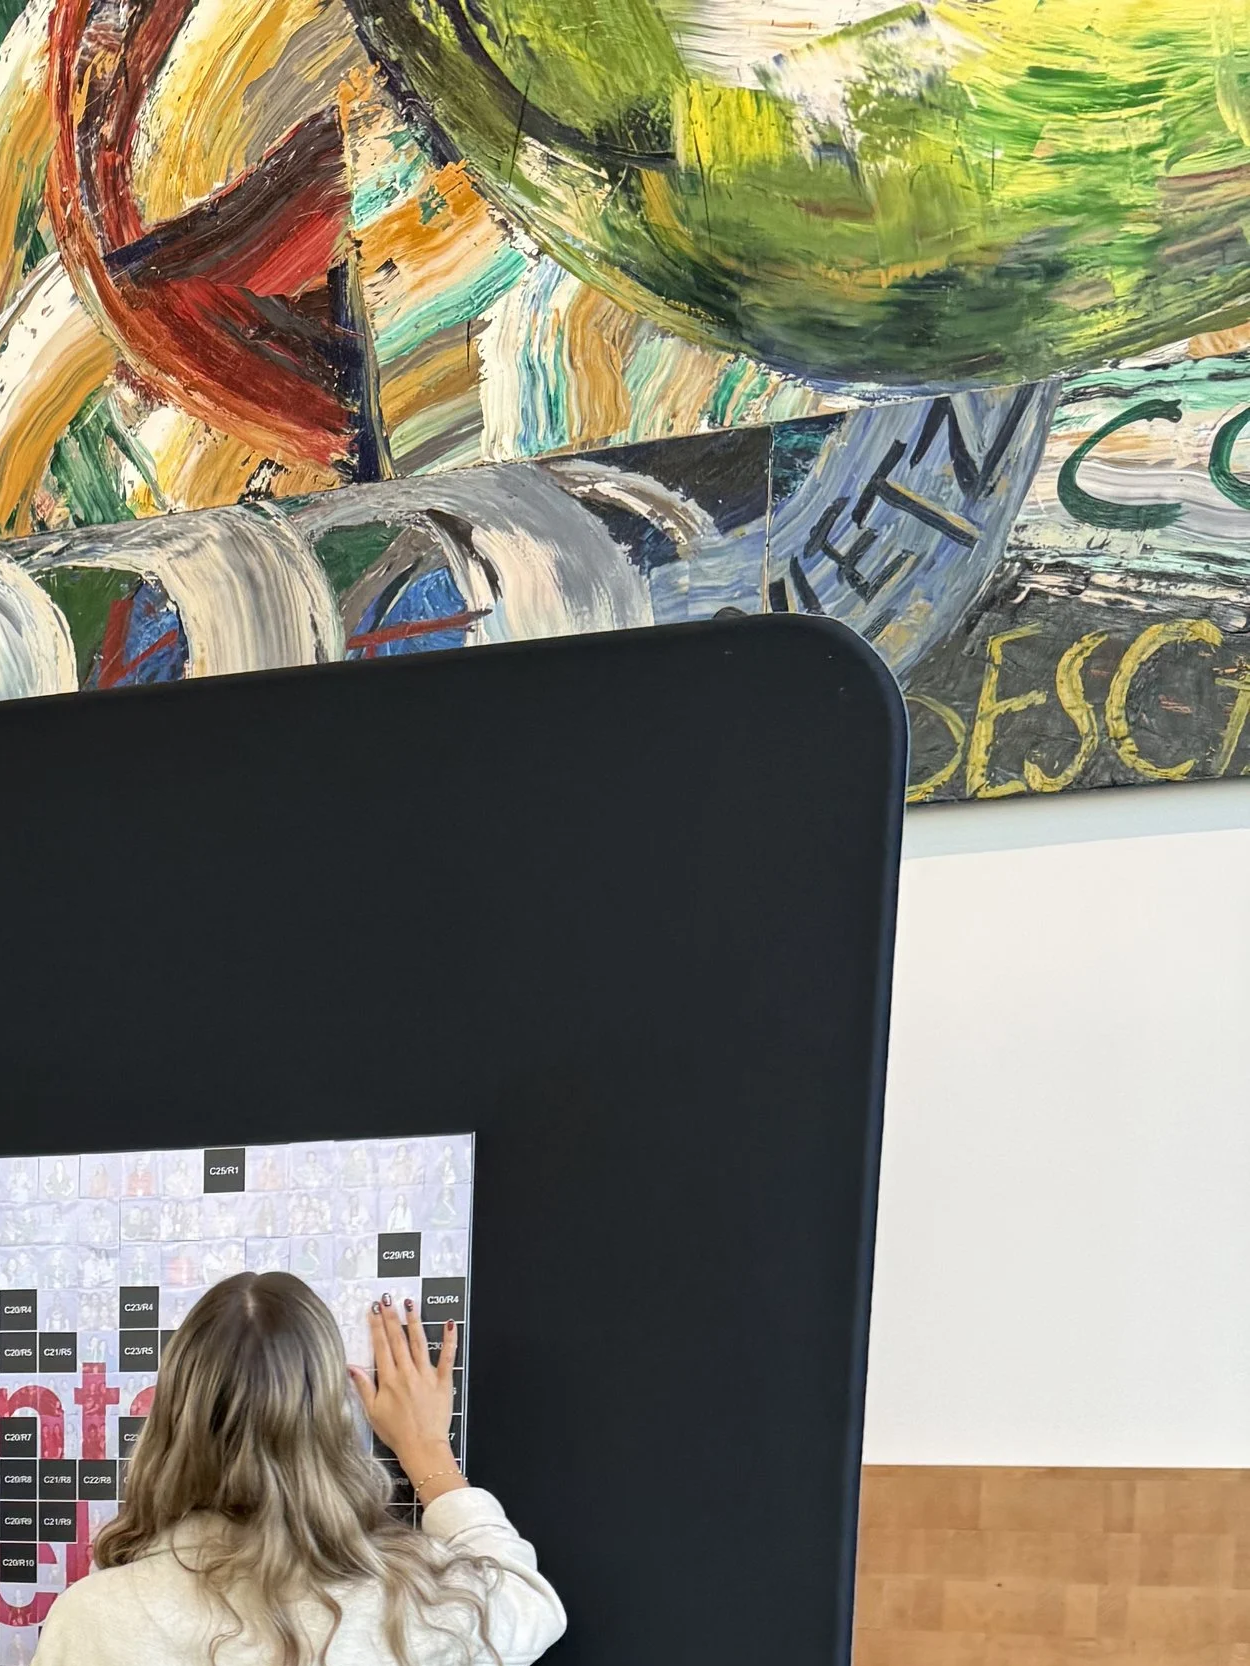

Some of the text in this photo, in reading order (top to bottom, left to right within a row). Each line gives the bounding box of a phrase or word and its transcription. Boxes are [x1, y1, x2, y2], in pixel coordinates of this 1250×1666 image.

[209, 1165, 239, 1176] C25/R1
[382, 1250, 415, 1260] C29/R3
[426, 1295, 460, 1305] C30/R4
[3, 1305, 32, 1315] C20/R4
[124, 1302, 154, 1312] C23/R4
[3, 1348, 33, 1357] C20/R5
[43, 1347, 73, 1357] C21/R5
[123, 1346, 154, 1356] C23/R5
[4, 1433, 33, 1442] C20/R7
[4, 1475, 33, 1484] C20/R8
[43, 1475, 72, 1484] C21/R8
[83, 1475, 112, 1485] C22/R8
[4, 1516, 33, 1526] C20/R9
[43, 1517, 72, 1526] C21/R9
[2, 1558, 35, 1567] C20/R10
